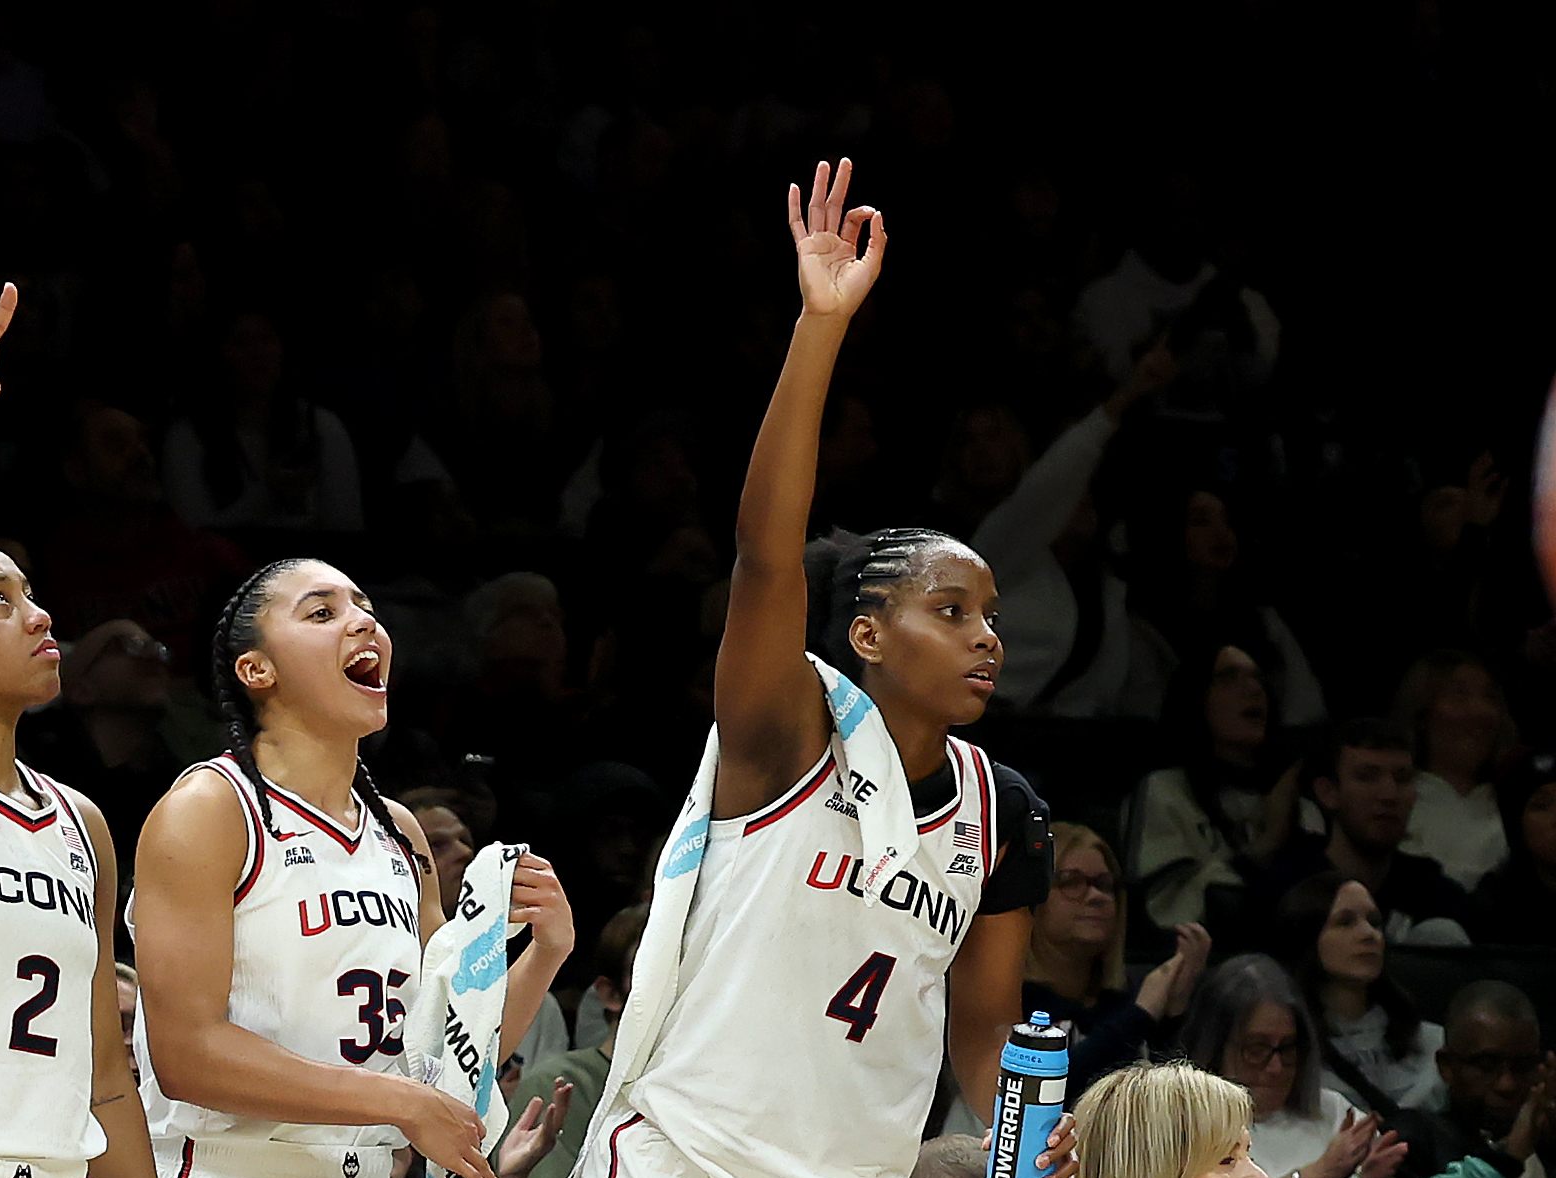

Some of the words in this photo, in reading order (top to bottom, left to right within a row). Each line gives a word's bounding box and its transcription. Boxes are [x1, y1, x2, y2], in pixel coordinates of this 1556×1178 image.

[949, 862, 980, 874] EAST
[955, 853, 976, 864] BIG
[9, 954, 60, 1057] 2
[337, 968, 411, 1064] 35
[825, 951, 897, 1044] 4
